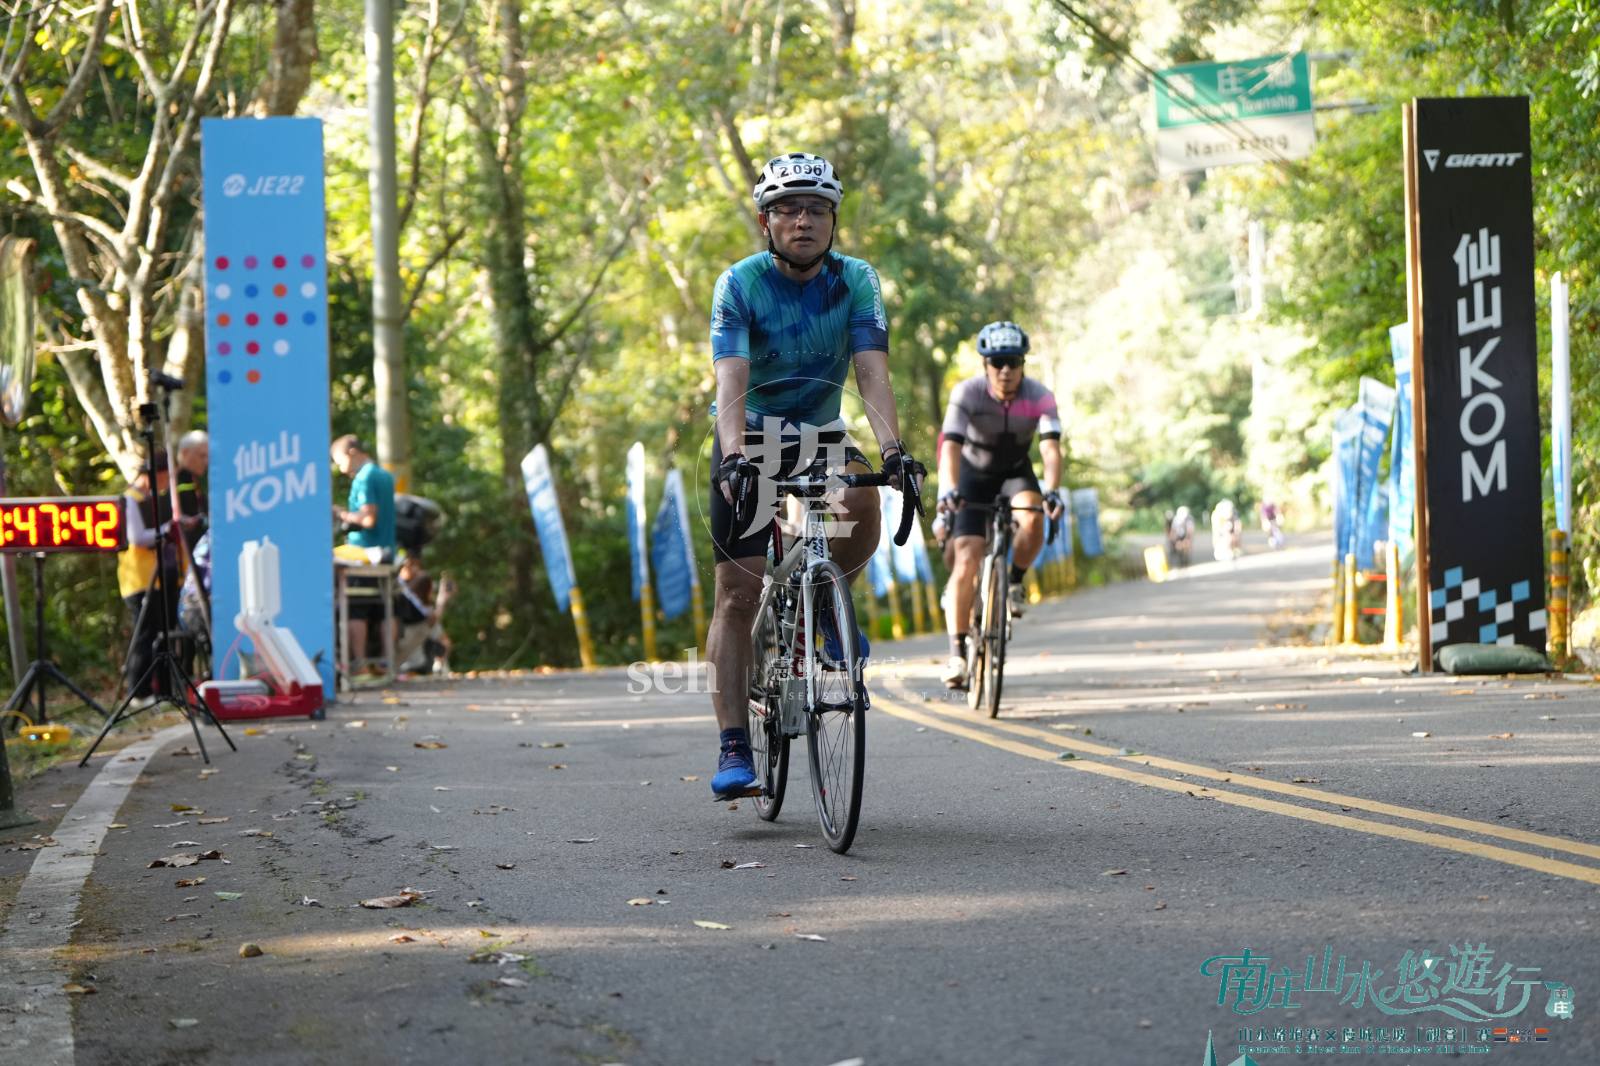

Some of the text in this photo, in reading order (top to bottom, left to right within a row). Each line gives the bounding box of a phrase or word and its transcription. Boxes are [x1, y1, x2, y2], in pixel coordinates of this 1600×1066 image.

[779, 164, 823, 178] 2096
[1445, 152, 1524, 169] GIANT
[248, 175, 305, 196] JE22
[233, 430, 301, 483] 仙山
[226, 462, 317, 523] KOM
[0, 502, 118, 547] :47:42
